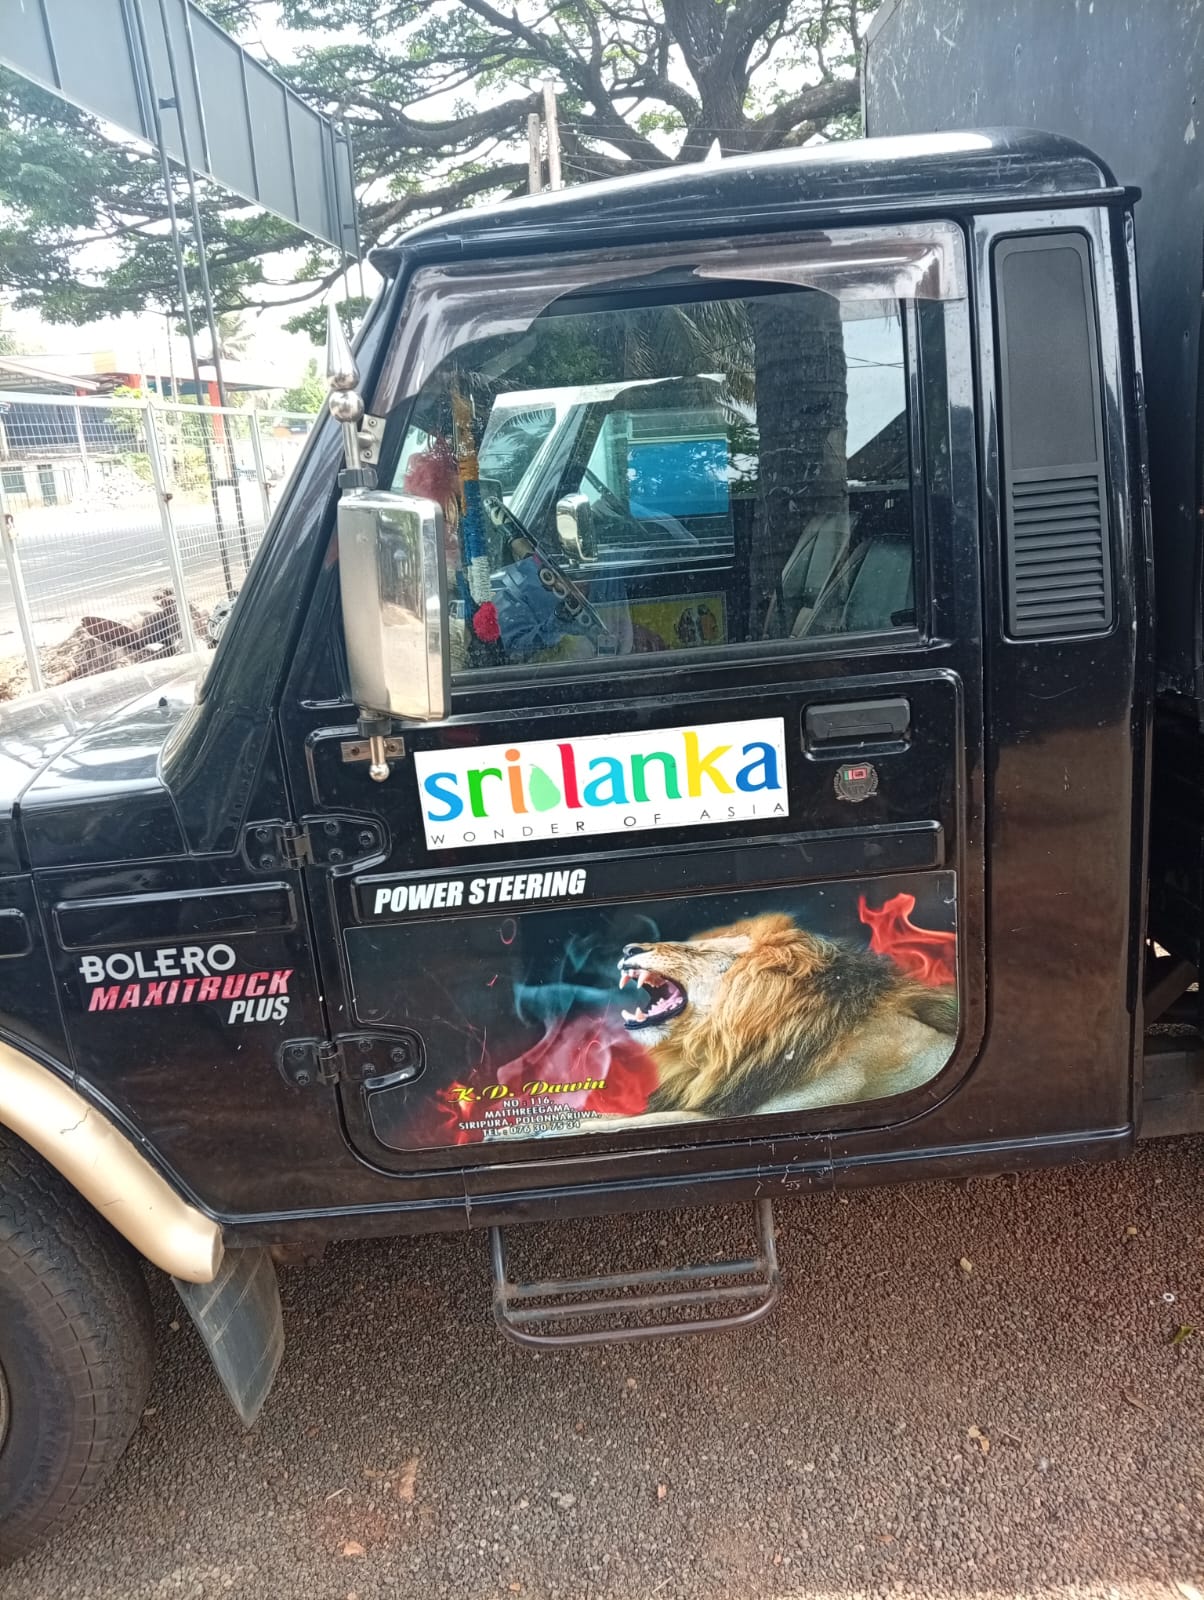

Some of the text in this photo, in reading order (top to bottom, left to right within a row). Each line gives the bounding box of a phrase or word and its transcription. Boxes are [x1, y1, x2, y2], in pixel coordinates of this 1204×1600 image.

[430, 802, 785, 845] WONDER OF ASIA
[373, 869, 588, 914] POWER STEERING
[79, 943, 236, 984] BOLERO
[87, 969, 295, 1012] MAXITRUCK
[227, 995, 291, 1025] PLUS
[521, 1077, 607, 1096] Dawin
